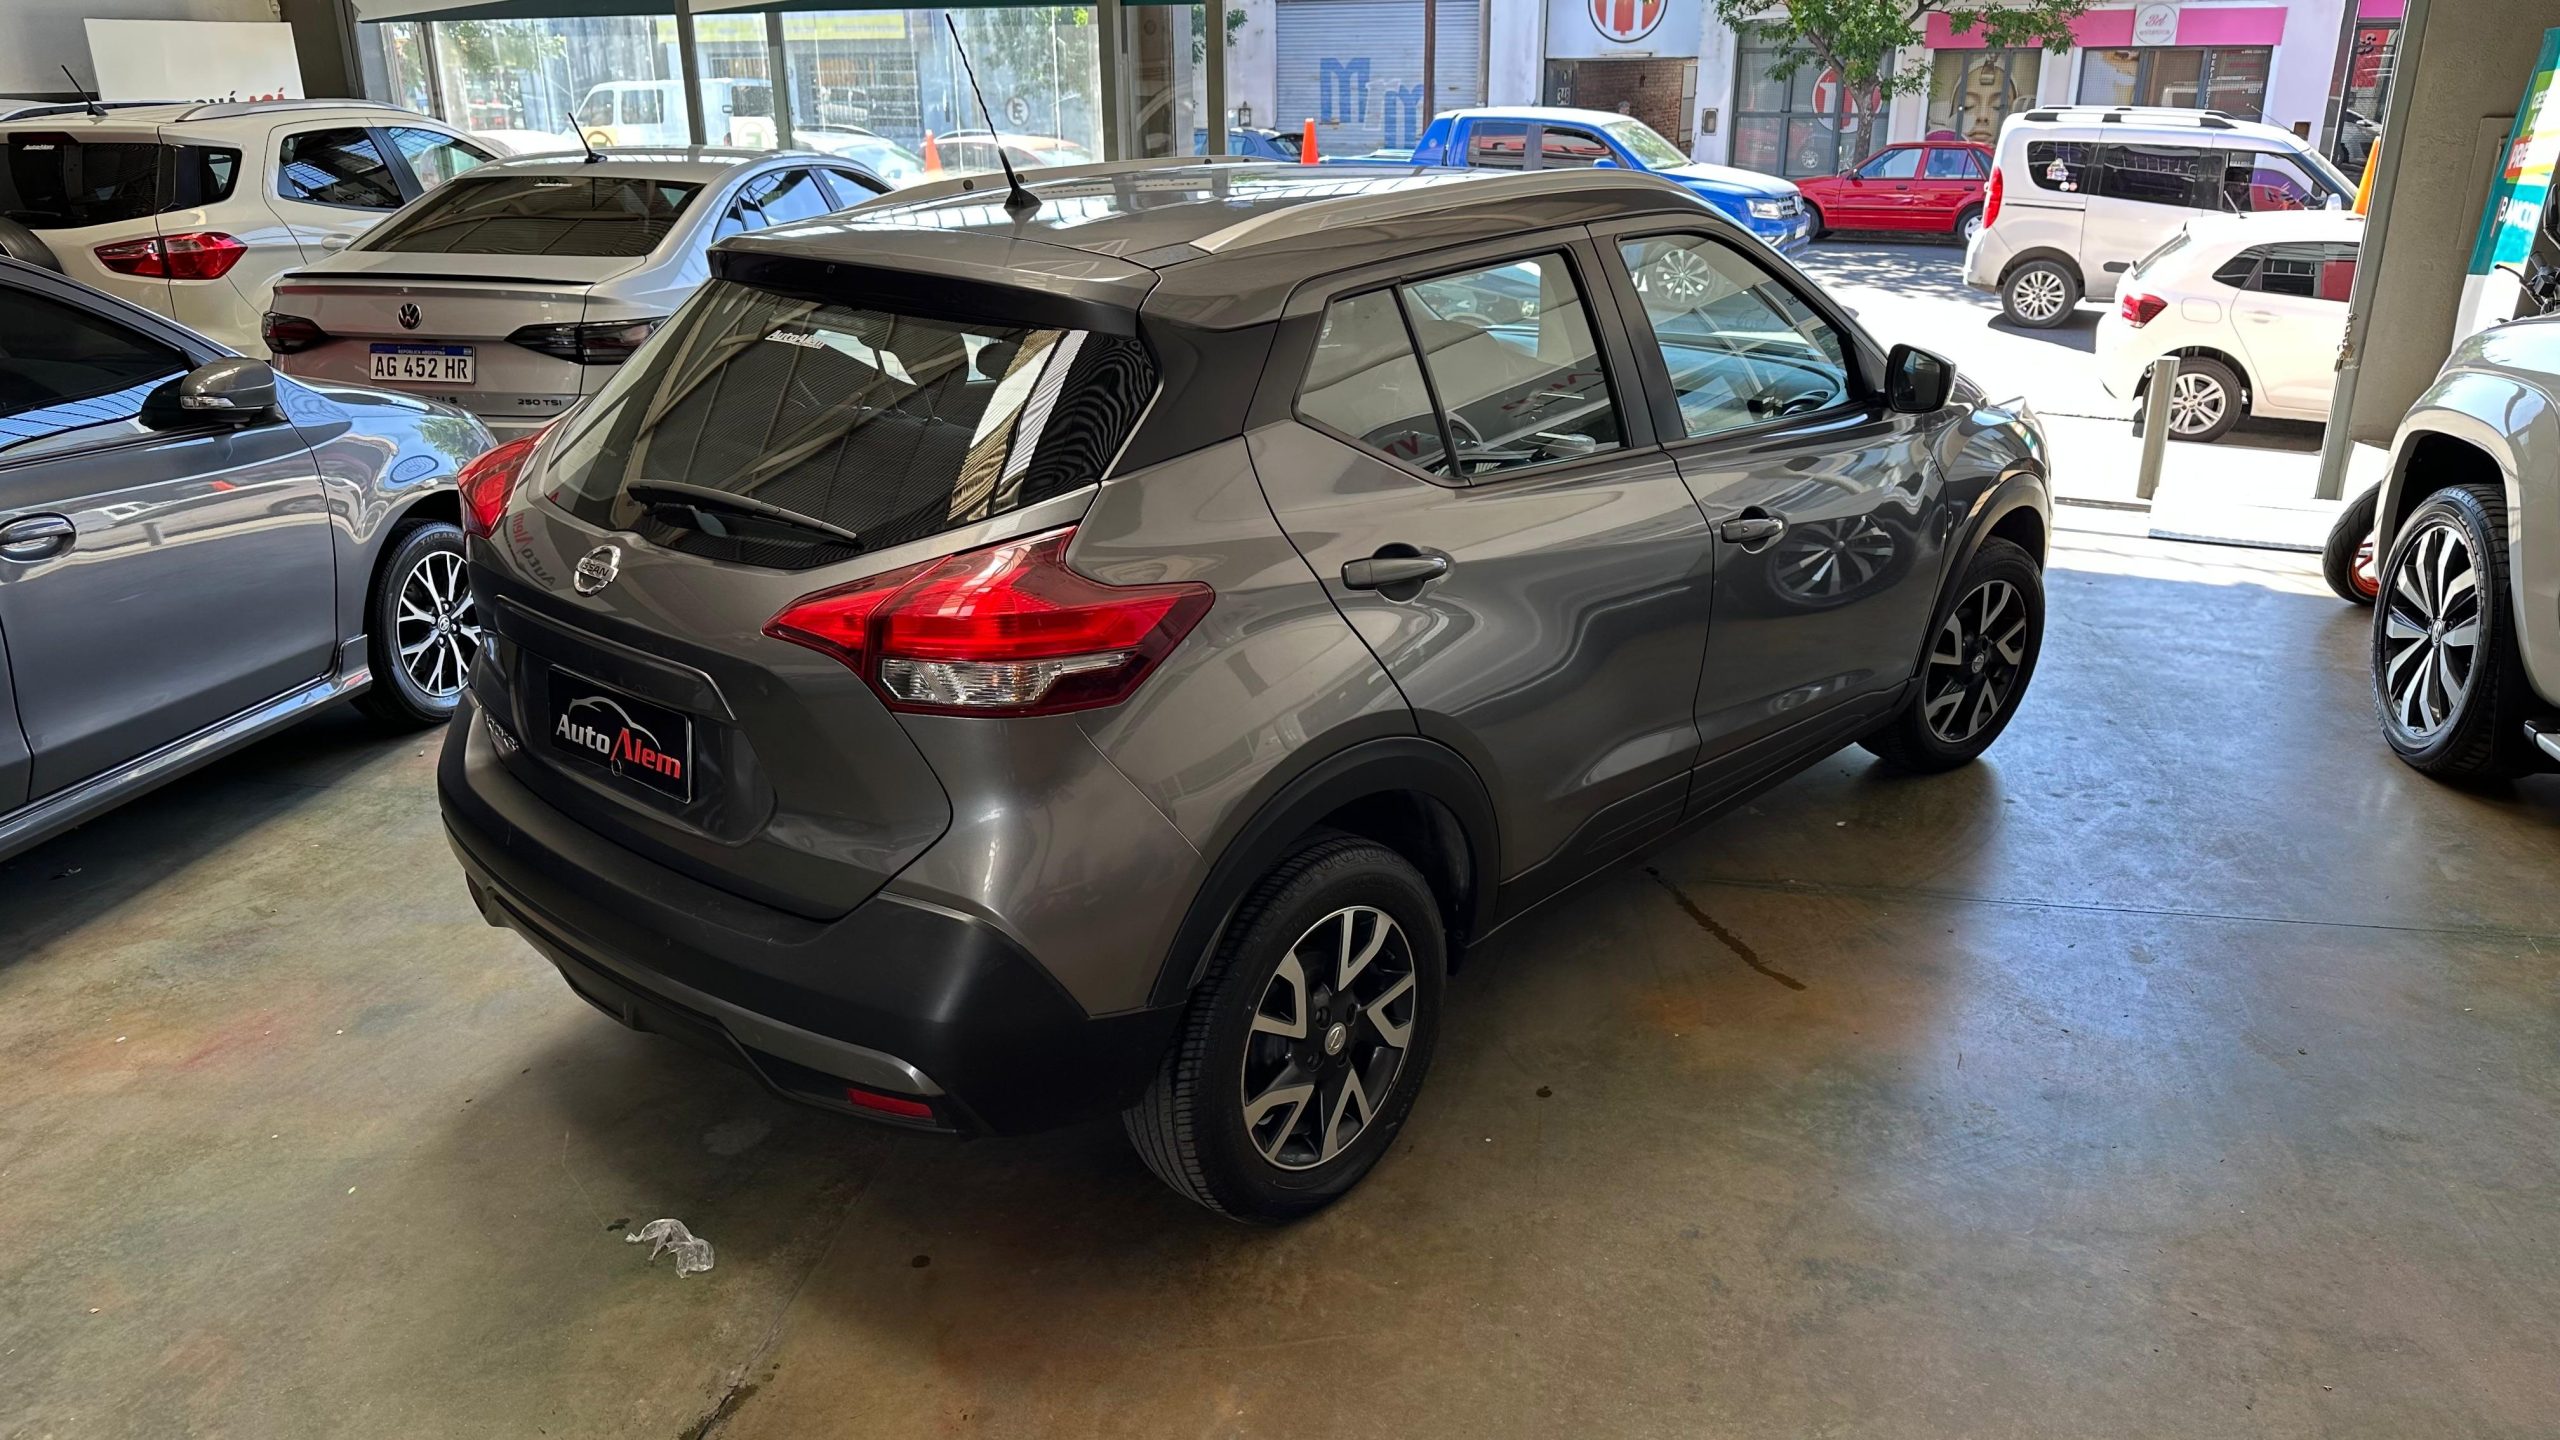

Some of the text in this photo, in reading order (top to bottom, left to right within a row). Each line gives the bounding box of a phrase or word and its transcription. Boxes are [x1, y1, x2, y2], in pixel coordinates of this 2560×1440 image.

[375, 356, 468, 380] AG 452 HR
[517, 397, 562, 407] 250 TSI
[556, 713, 682, 780] Auto Alem
